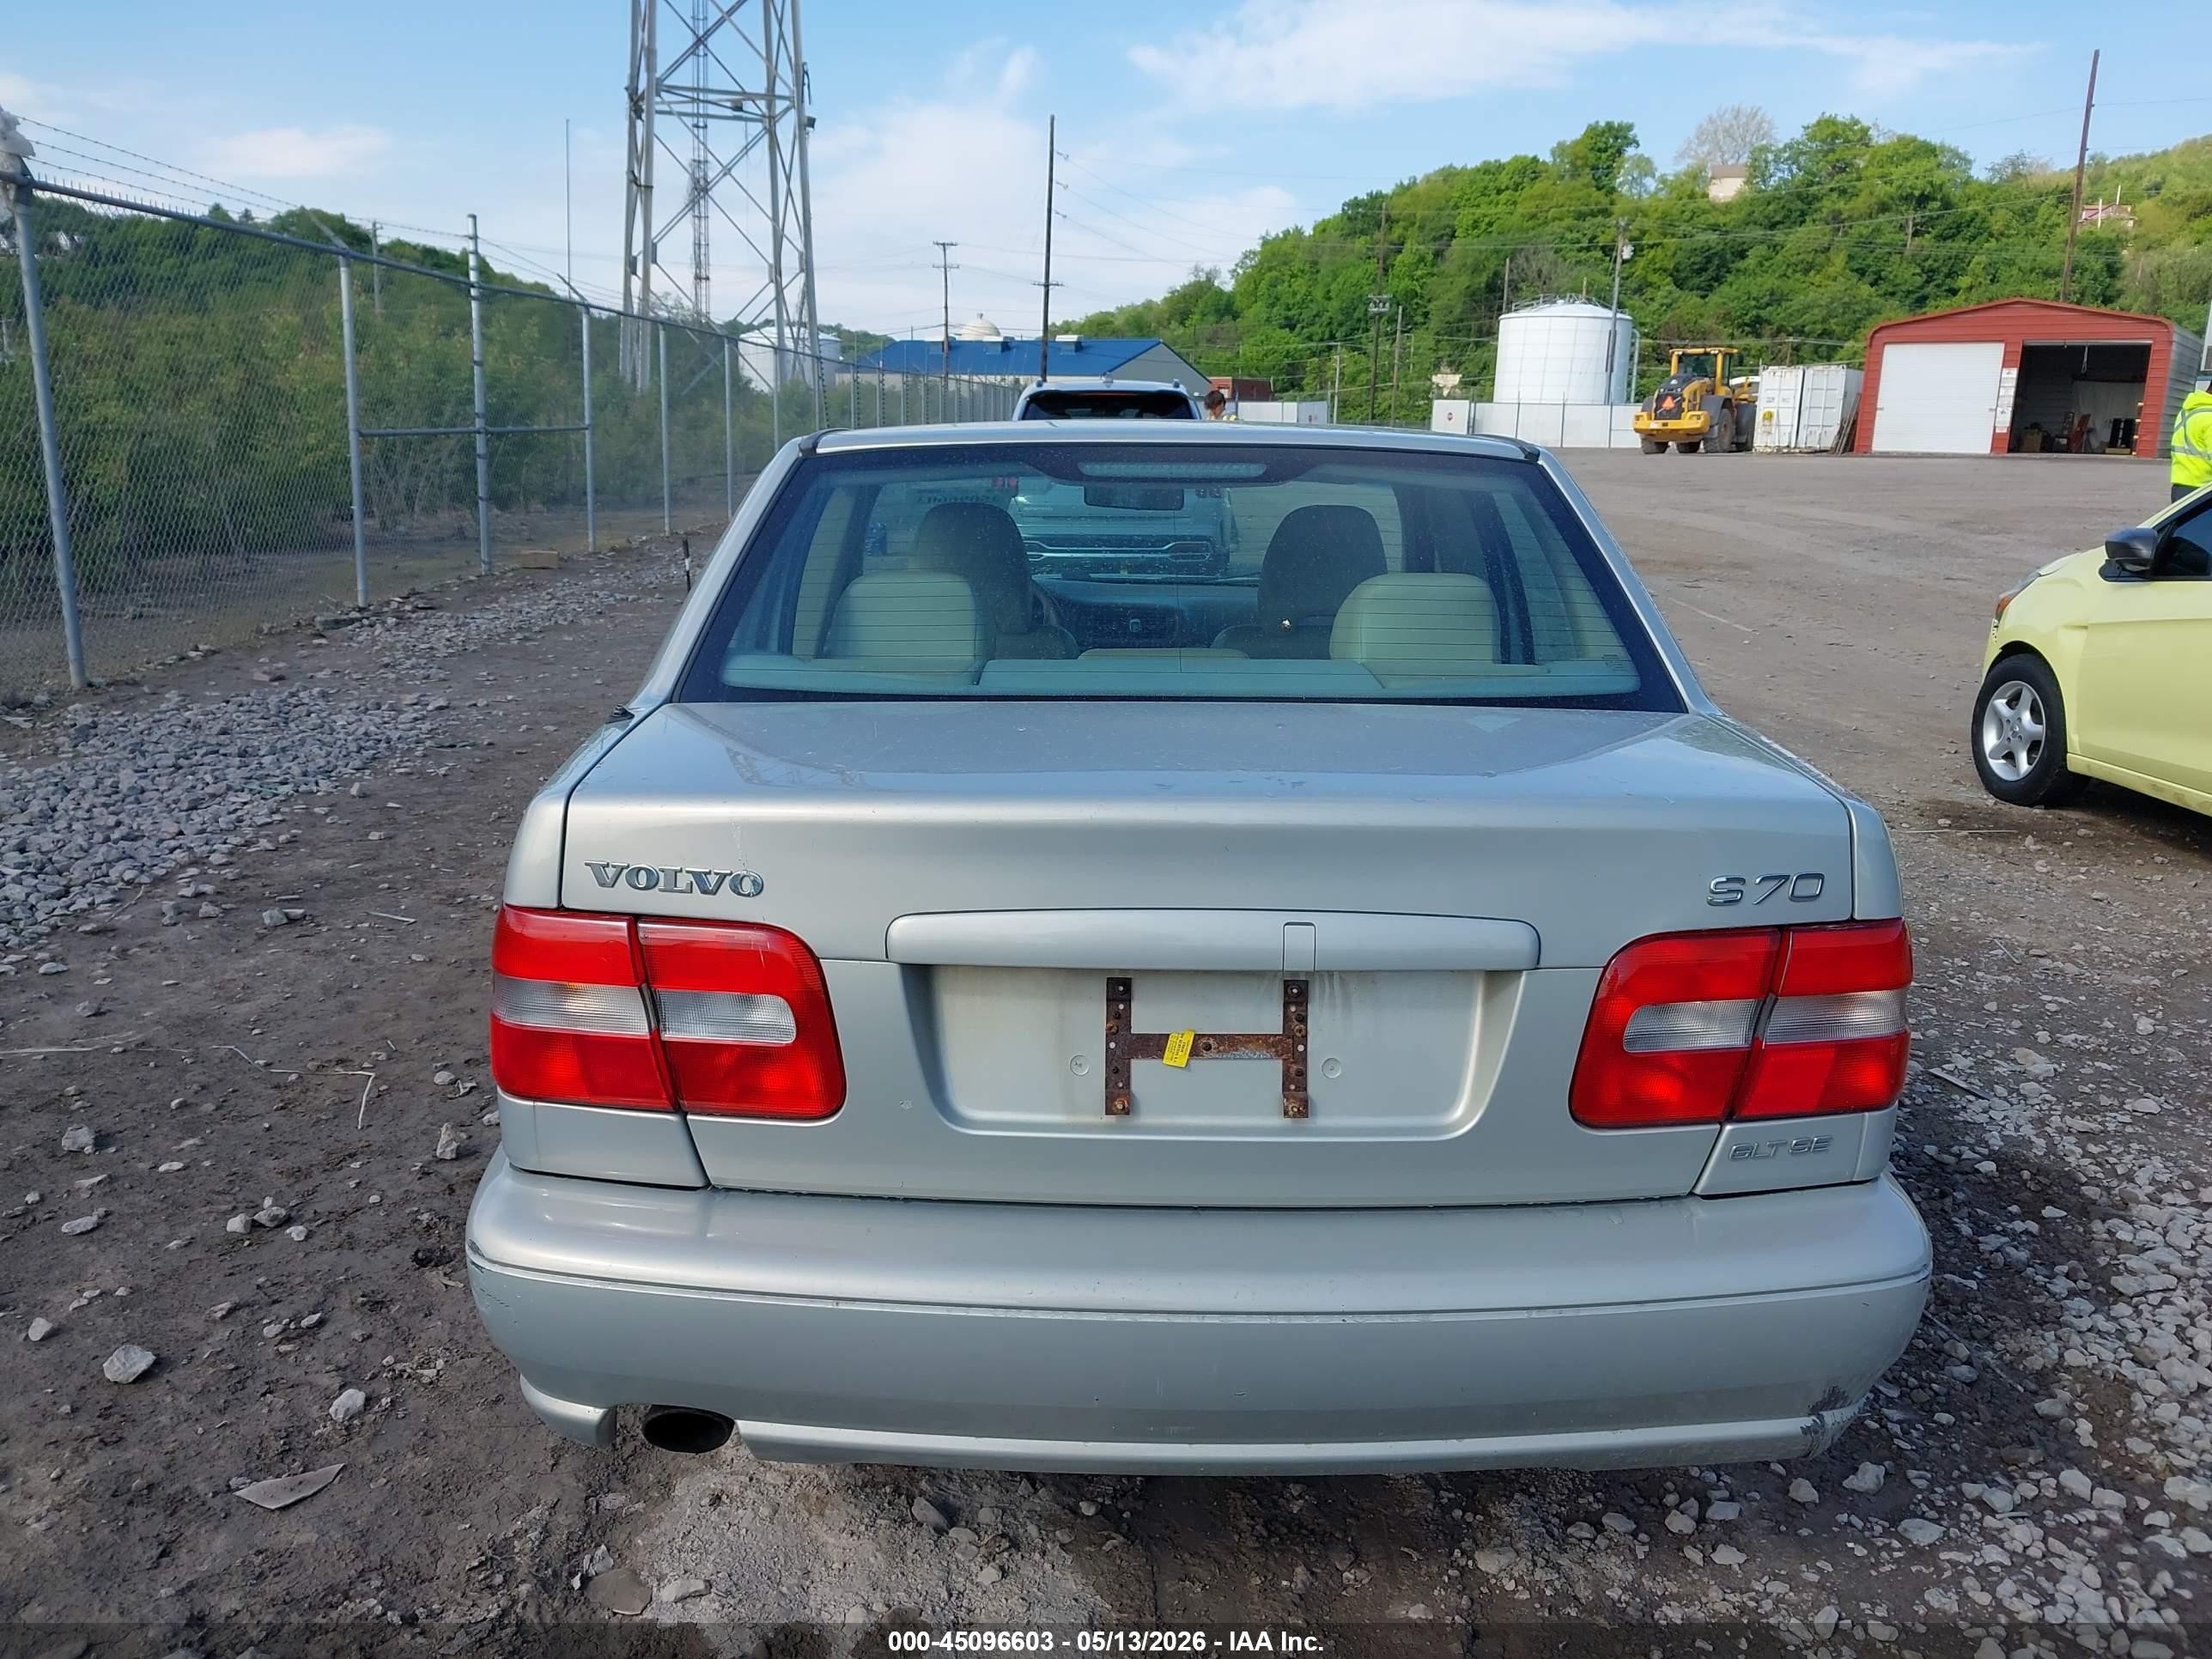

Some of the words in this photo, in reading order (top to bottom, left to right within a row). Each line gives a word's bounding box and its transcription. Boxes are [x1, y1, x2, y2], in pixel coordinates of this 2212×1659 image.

[584, 860, 764, 897] VOLVO
[1706, 872, 1826, 906] S70
[1729, 1139, 1787, 1160] GLT
[1789, 1134, 1834, 1156] SE
